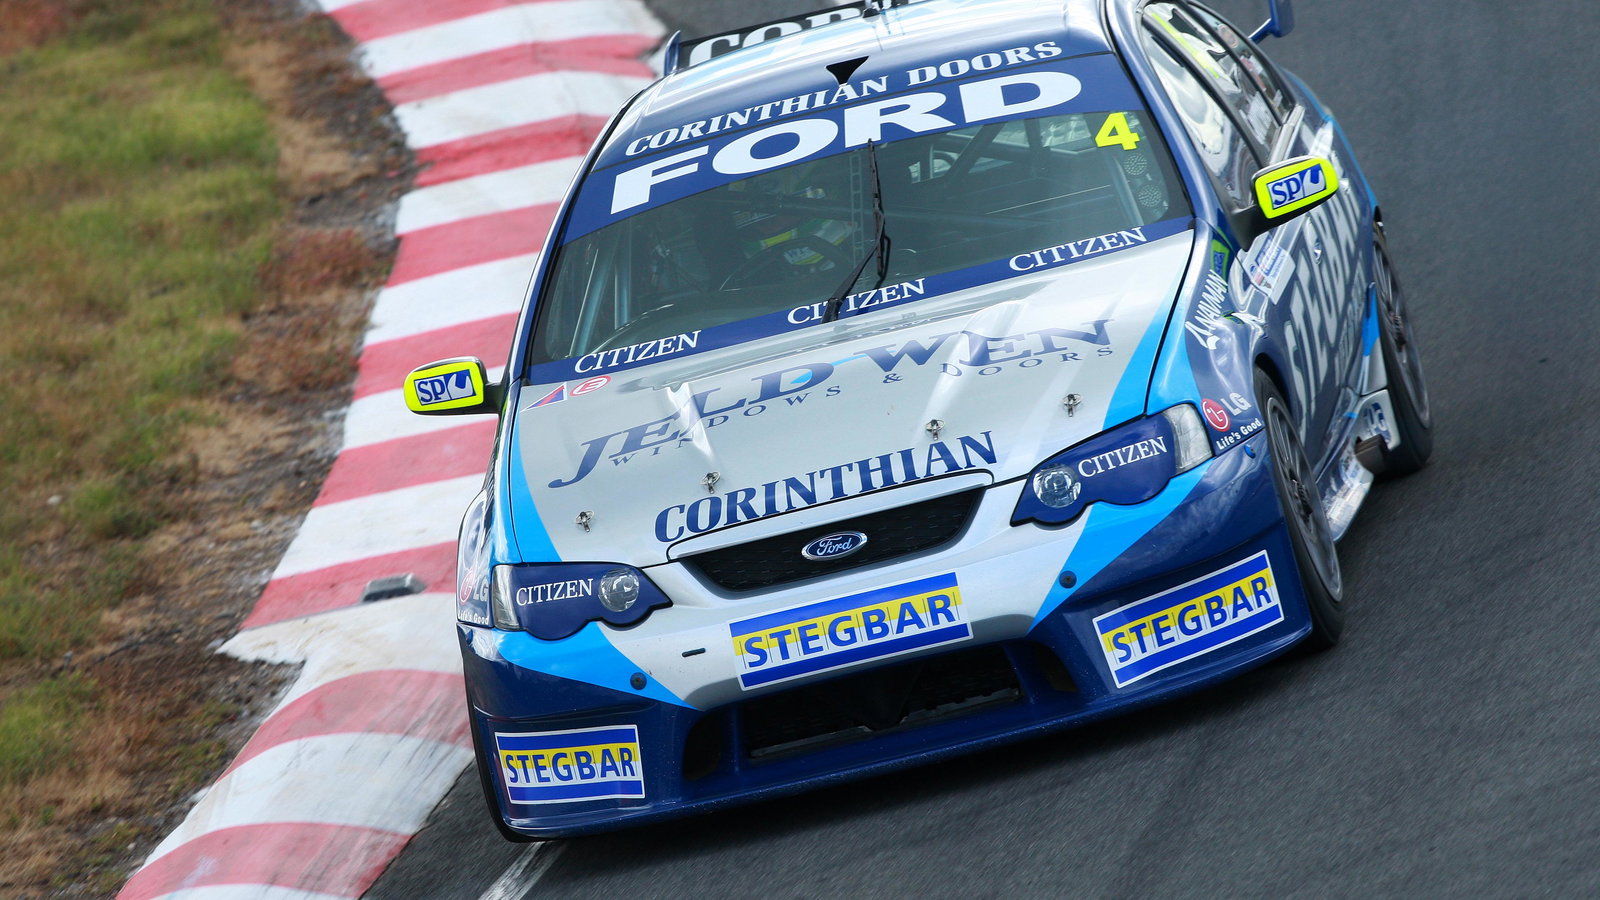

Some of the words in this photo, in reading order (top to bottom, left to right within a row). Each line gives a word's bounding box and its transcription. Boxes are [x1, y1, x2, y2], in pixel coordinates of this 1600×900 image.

[625, 76, 888, 157] CORINTHIAN
[906, 40, 1062, 84] DOORS
[610, 71, 1082, 214] FORD
[1095, 112, 1140, 150] 4
[1009, 227, 1147, 272] CITIZEN
[787, 278, 926, 325] CIIZEN
[1195, 268, 1229, 331] NAVMAN
[574, 330, 702, 374] CITIZEN
[882, 373, 904, 384] &
[940, 346, 1114, 377] DOORS
[1220, 392, 1252, 416] LG
[1216, 432, 1242, 450] Life's
[1240, 418, 1262, 436] Good
[1078, 436, 1167, 478] CITIZEN
[655, 431, 998, 543] CORINTHIAN
[816, 536, 852, 557] Ford
[473, 575, 489, 602] LG
[515, 578, 593, 606] CITIZEN
[743, 593, 956, 668] STEGBAR
[1113, 575, 1273, 663] STEGBAR
[505, 748, 637, 783] STEGBAR
